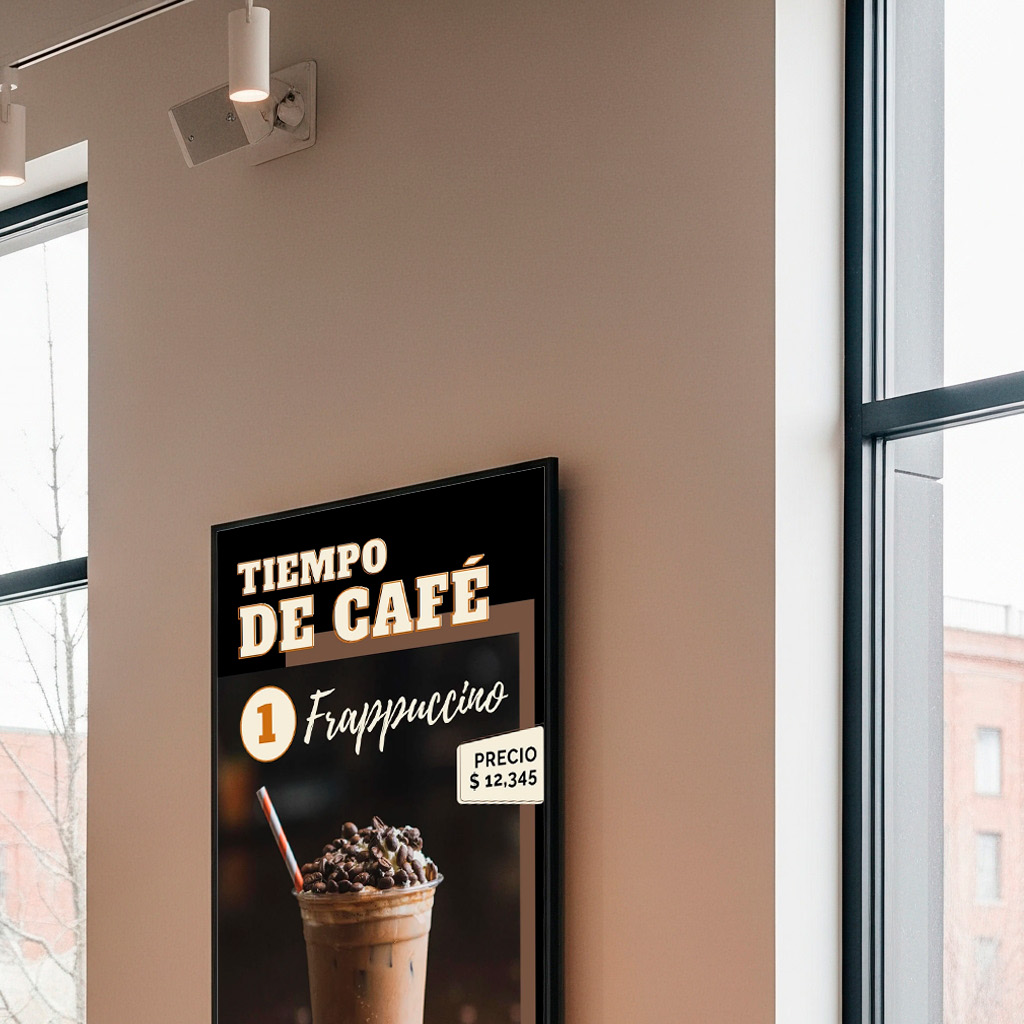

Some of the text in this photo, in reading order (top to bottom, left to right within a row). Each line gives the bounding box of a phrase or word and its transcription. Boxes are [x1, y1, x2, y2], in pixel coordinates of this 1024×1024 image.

[237, 537, 387, 596] TIEMPO
[237, 553, 490, 660] DE CAFÉ
[256, 680, 509, 756] 1 Frappuccino
[469, 769, 538, 792] $ 12,345
[474, 746, 537, 769] PRECIO
